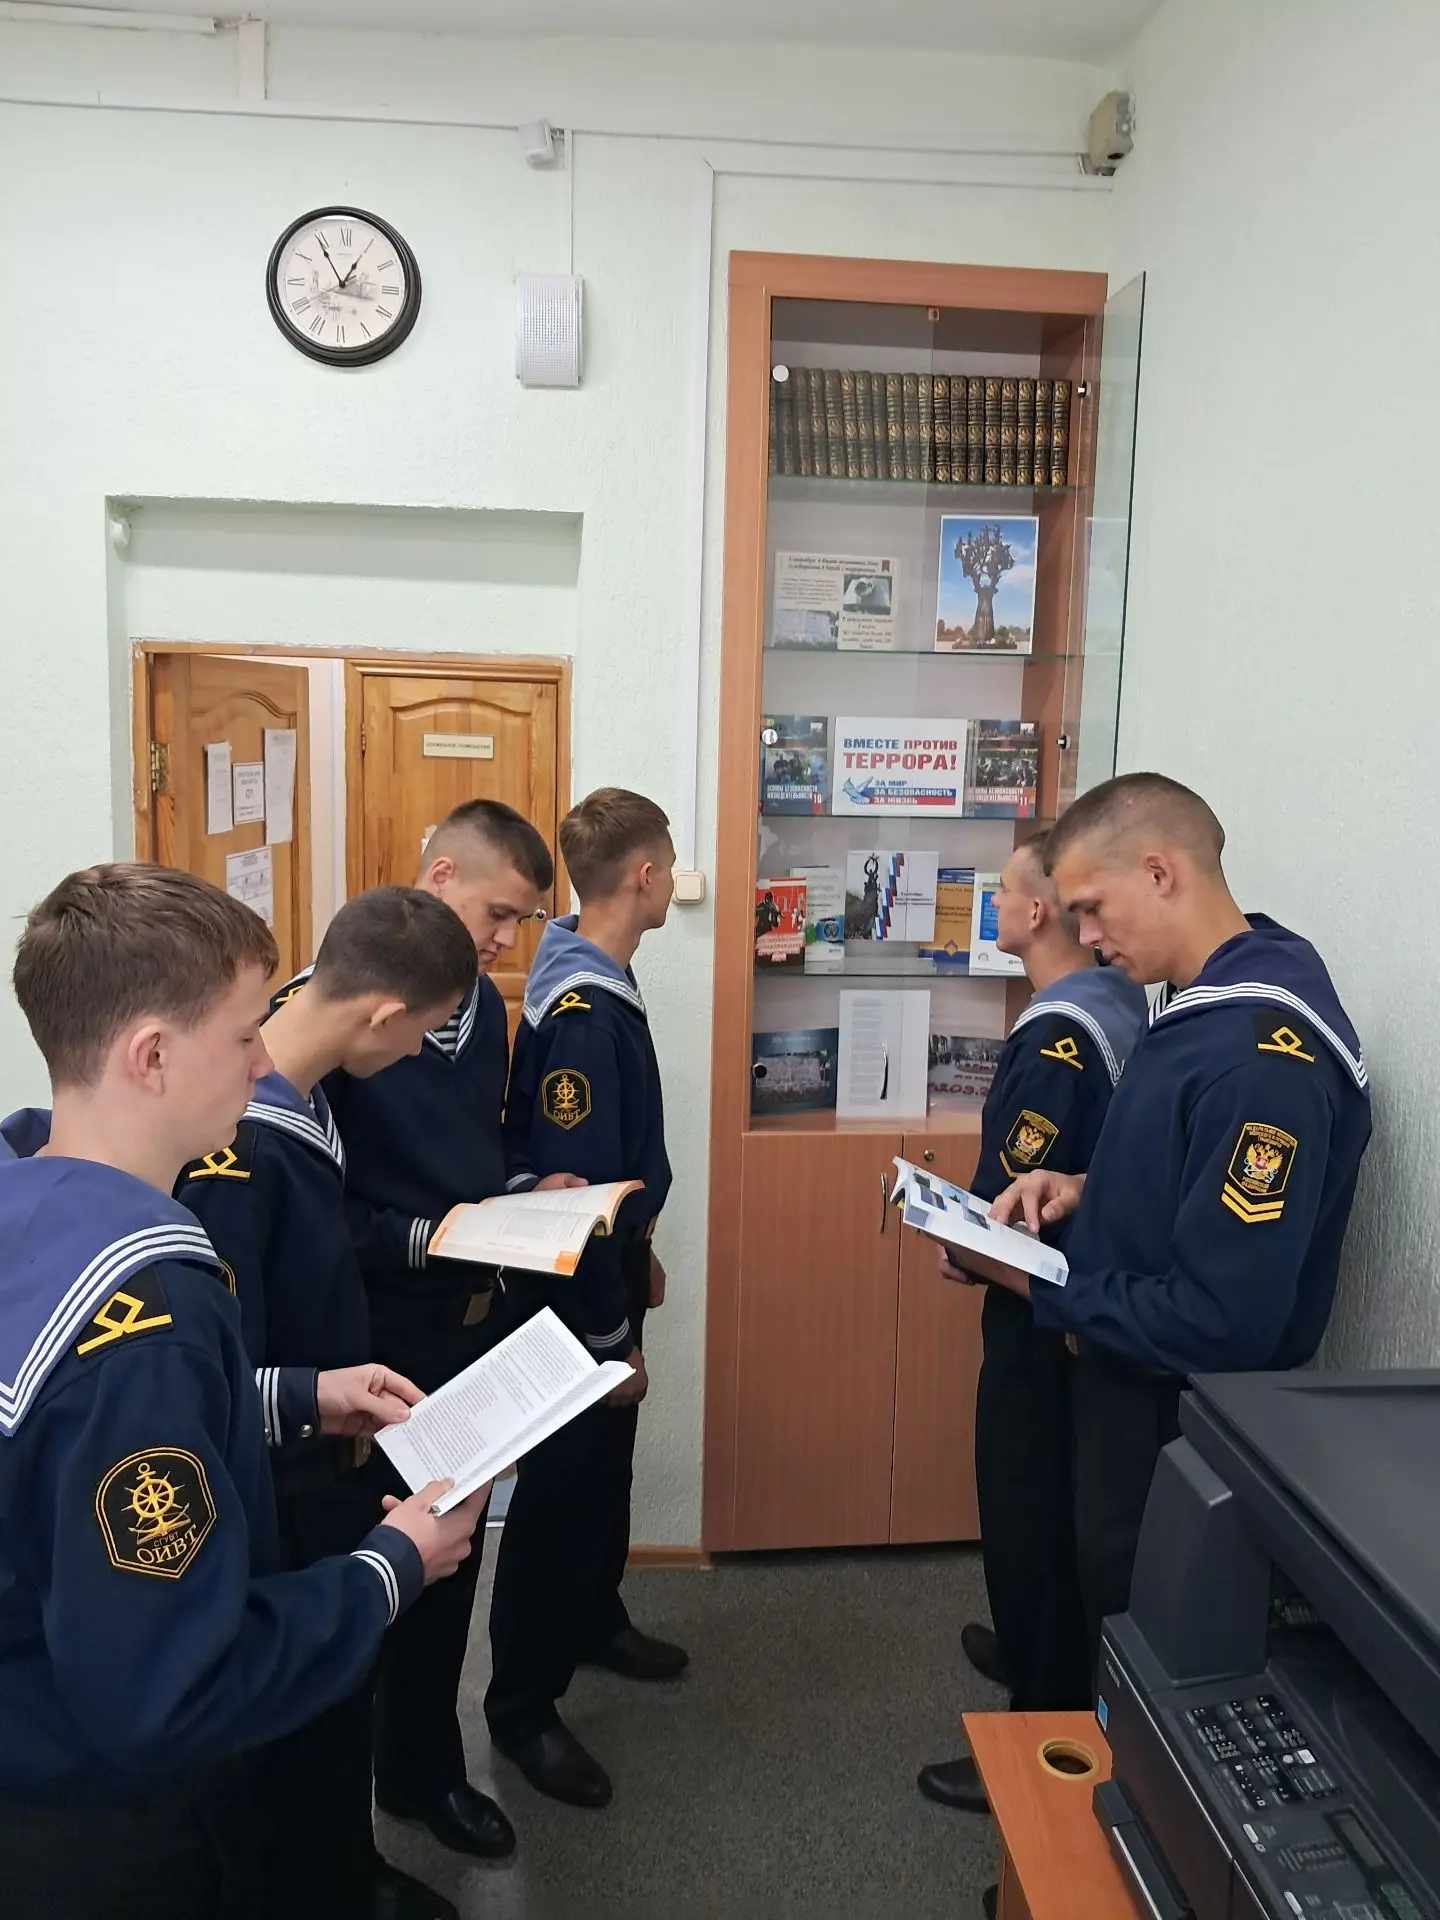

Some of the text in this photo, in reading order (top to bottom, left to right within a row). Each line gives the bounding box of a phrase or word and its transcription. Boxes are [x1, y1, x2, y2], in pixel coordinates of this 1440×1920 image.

[843, 738, 958, 751] ВМЕСТЕ ПРОТИВ
[843, 752, 957, 771] ТЕРРОРА!
[813, 793, 822, 804] 10
[874, 788, 953, 797] ЗА БЕЗОПАСНОСТЬ
[873, 796, 918, 805] ЗА ЖИЗНЬ
[1020, 796, 1028, 806] 11
[552, 1108, 581, 1121] ОИВТ
[136, 1523, 197, 1564] ОИВТ
[153, 1531, 179, 1547] СГУВТ
